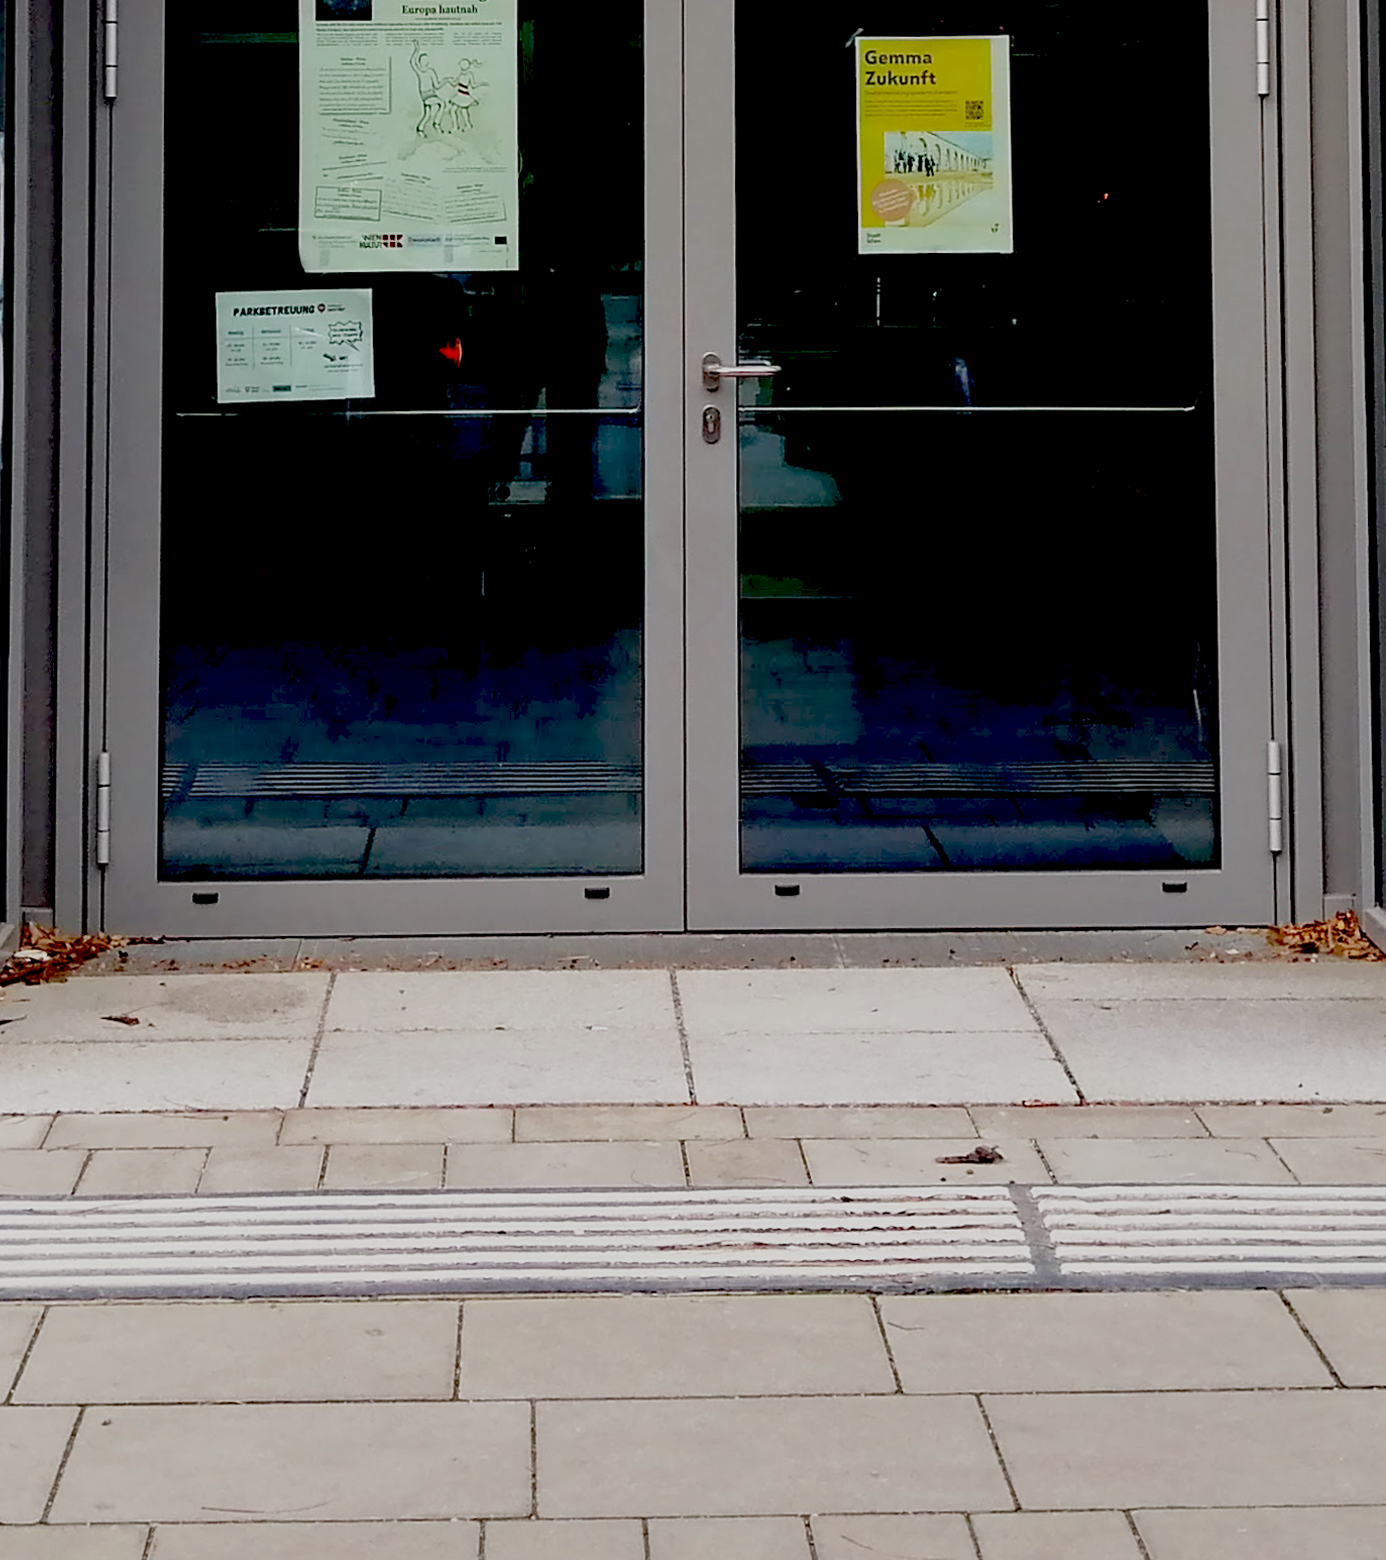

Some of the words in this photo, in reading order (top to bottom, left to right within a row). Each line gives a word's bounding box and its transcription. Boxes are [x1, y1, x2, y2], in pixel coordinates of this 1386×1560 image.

[401, 4, 438, 16] Europa
[439, 4, 478, 15] hautnah
[864, 49, 933, 65] Gemma
[865, 70, 937, 86] Zukunft
[232, 305, 315, 317] PARKBETREUUNG
